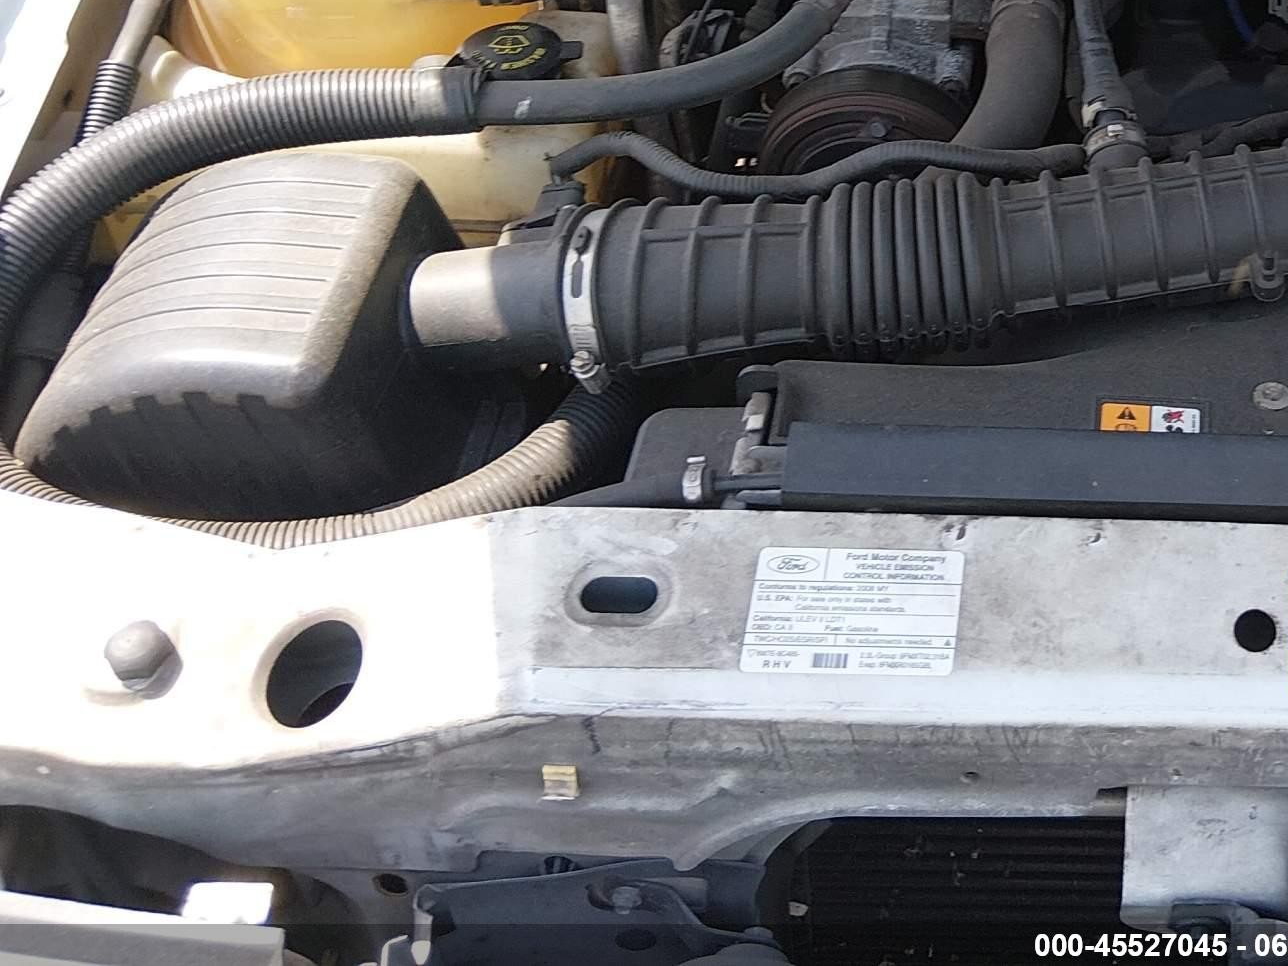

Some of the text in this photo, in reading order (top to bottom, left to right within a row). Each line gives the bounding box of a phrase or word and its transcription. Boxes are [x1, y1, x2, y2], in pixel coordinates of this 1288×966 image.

[846, 553, 946, 564] Ford Motor Company
[776, 557, 809, 571] Ford
[856, 563, 935, 572] VEHICLE EMISSION
[843, 572, 885, 580] CONTROL
